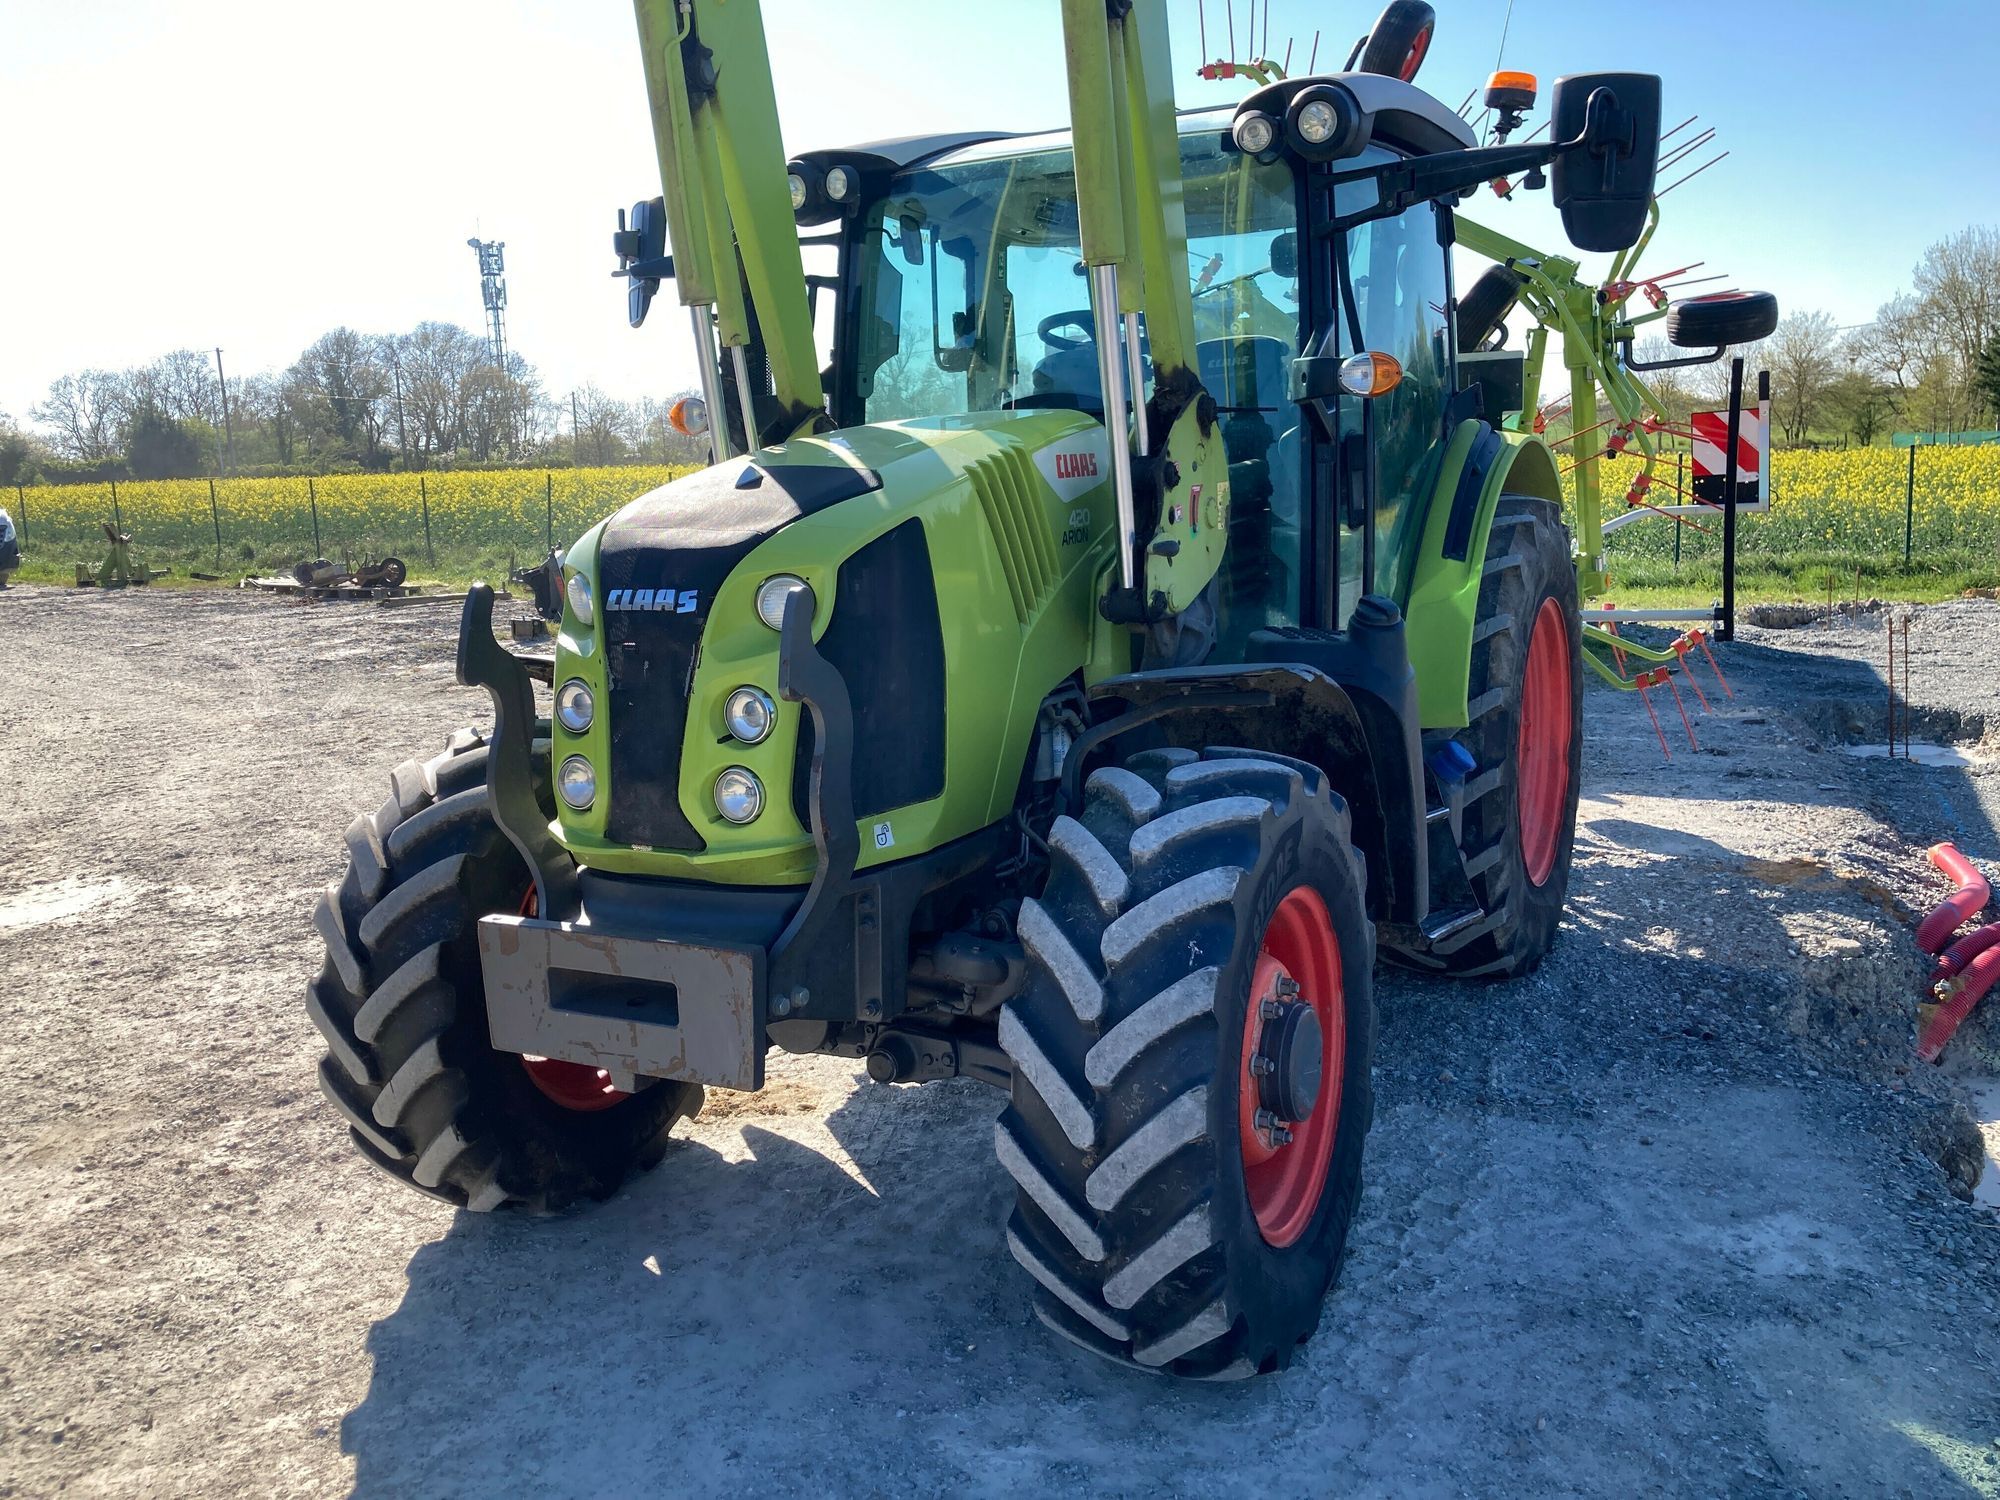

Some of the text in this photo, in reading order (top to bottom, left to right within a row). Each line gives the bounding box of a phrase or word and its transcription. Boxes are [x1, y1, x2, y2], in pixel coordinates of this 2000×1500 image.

[1056, 453, 1098, 478] CLAAS
[1068, 508, 1091, 527] 420
[1061, 528, 1089, 547] ARION
[606, 589, 698, 613] CLAAS
